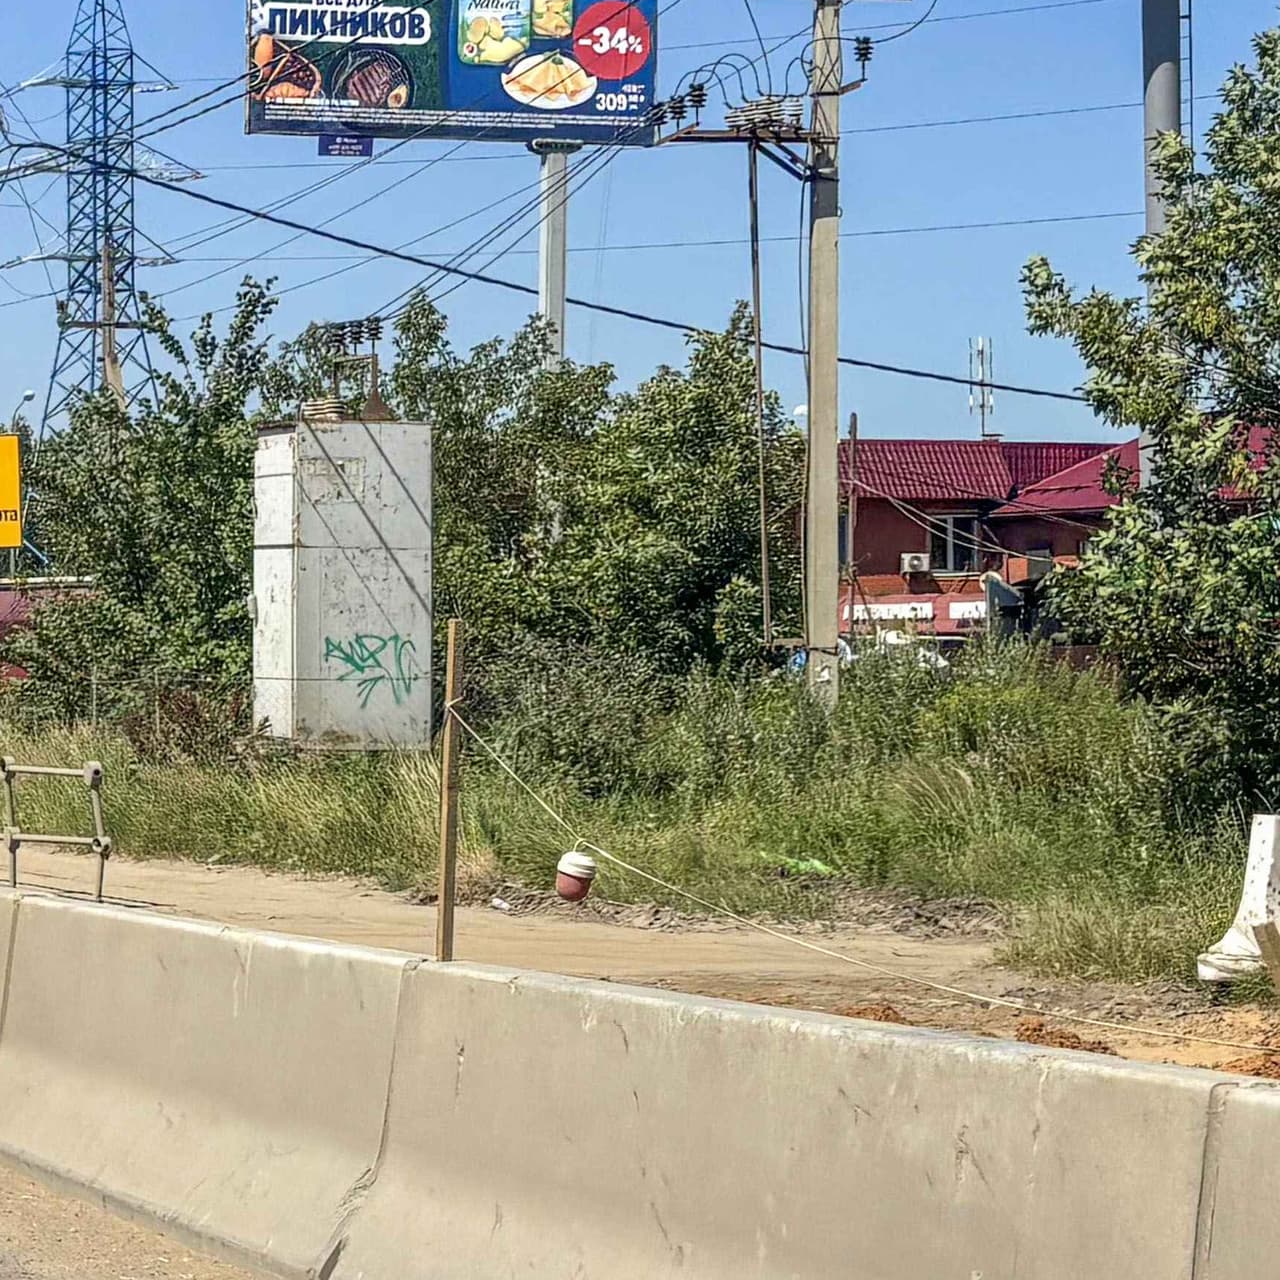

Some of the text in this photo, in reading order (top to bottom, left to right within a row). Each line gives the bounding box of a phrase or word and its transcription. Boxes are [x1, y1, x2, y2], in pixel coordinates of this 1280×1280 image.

[268, 8, 425, 39] ПИКНИКОВ
[578, 26, 643, 54] -34%
[596, 93, 628, 111] 309
